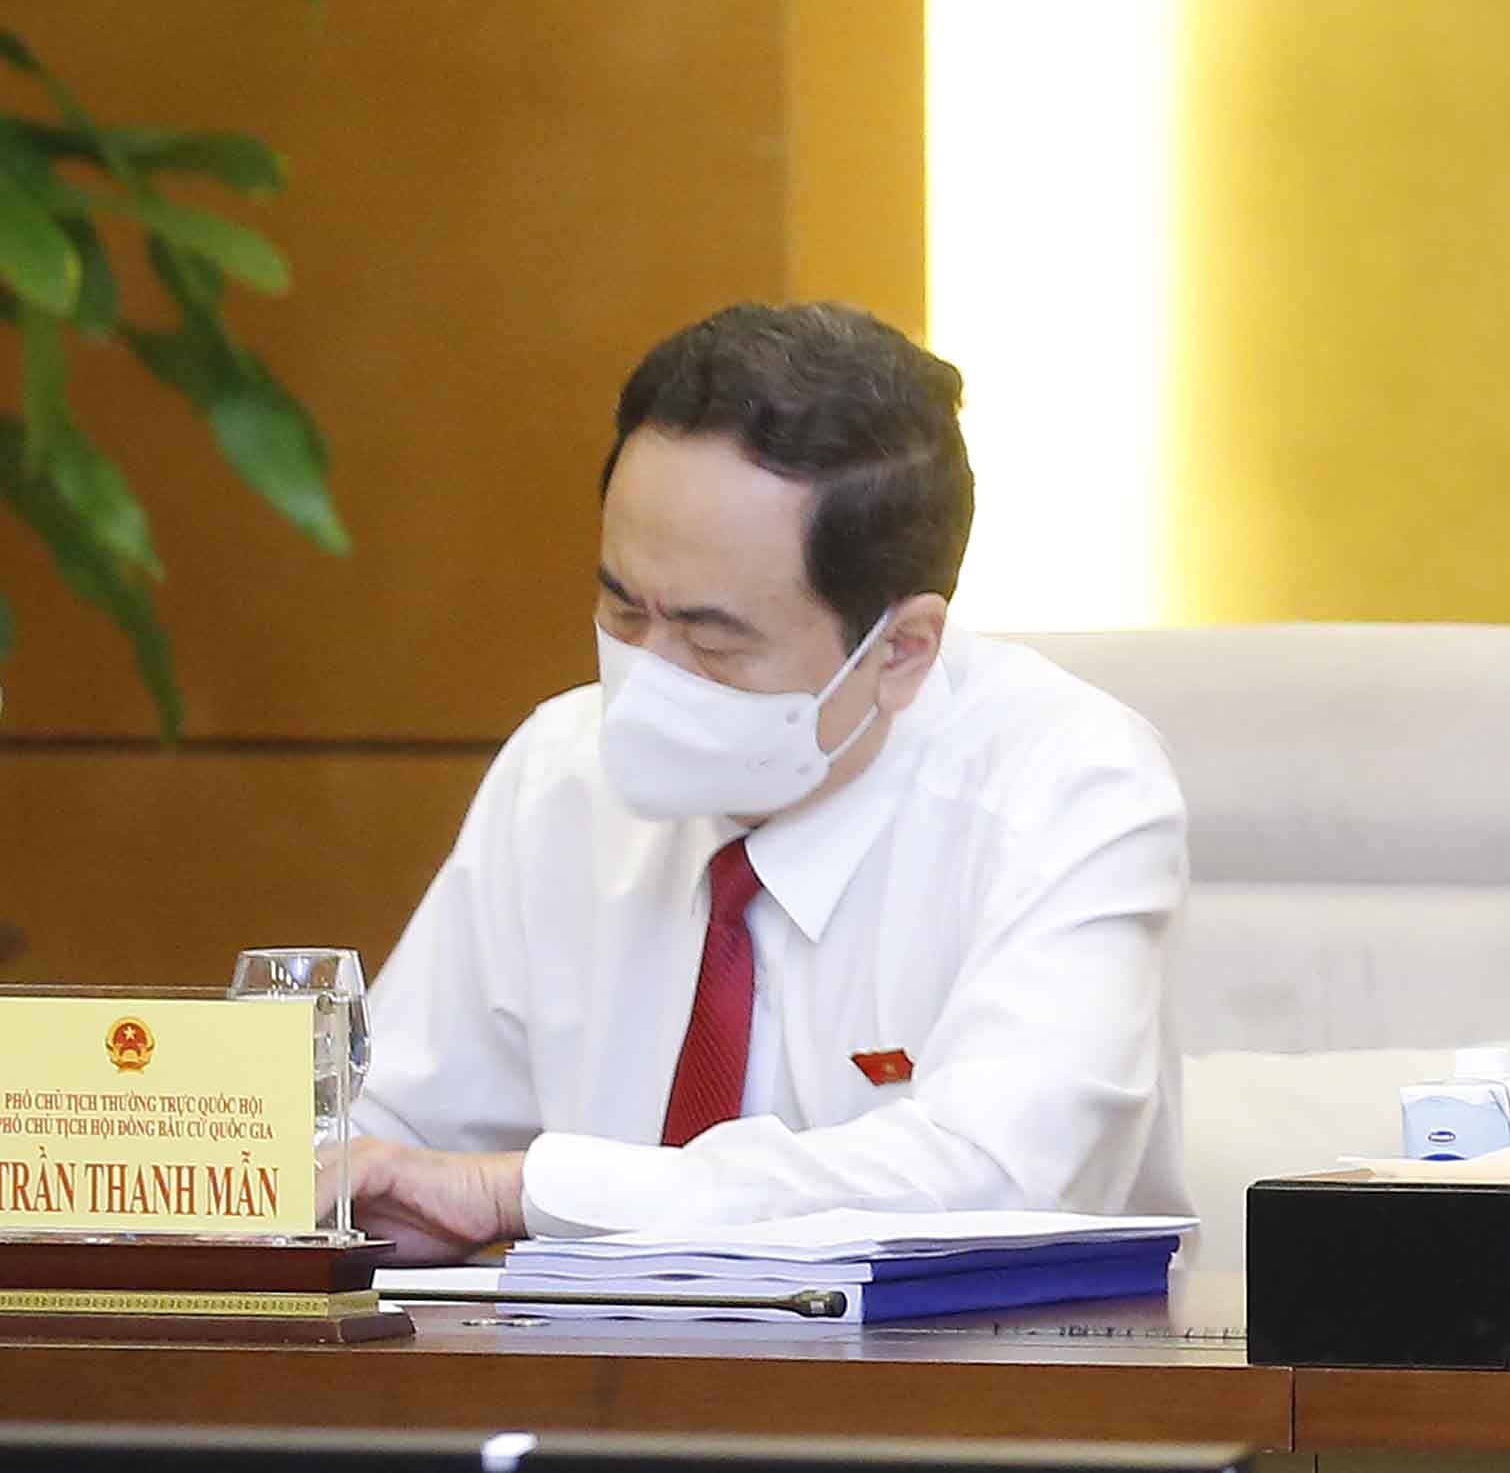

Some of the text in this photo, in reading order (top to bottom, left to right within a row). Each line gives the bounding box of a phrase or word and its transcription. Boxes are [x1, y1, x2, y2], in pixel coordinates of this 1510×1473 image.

[5, 1088, 263, 1118] PHÓ CHỦ TỊCH THƯỜNG TRỰC QUỐC HỘI
[25, 1113, 54, 1134] CHỦ
[56, 1118, 87, 1138] TỊCH
[90, 1117, 115, 1139] HỘI
[118, 1115, 155, 1137] ĐỒNG
[158, 1115, 185, 1137] BẦU
[187, 1117, 207, 1138] CỬ
[209, 1117, 248, 1141] QUỐC
[250, 1122, 273, 1139] GIA
[84, 1163, 197, 1214] THANH
[205, 1150, 279, 1217] MẪN
